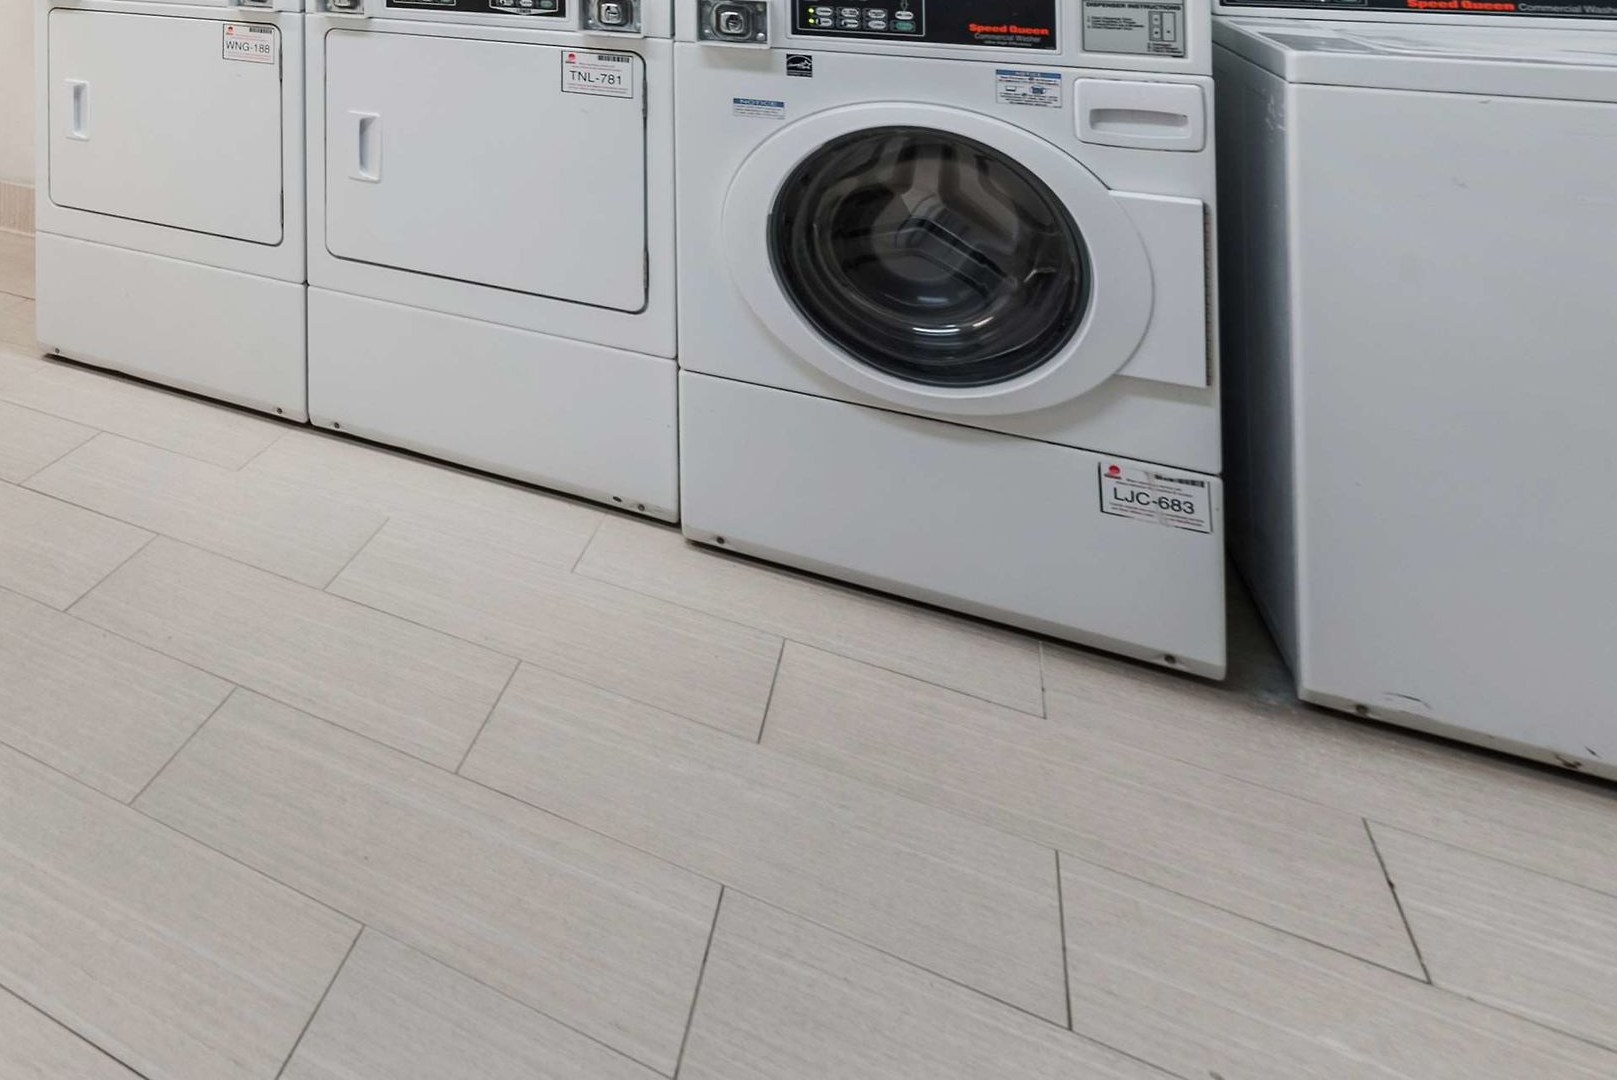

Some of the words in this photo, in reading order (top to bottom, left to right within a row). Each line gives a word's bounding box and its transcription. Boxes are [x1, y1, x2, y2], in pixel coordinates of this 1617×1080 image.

[1461, 0, 1515, 11] Queen
[1518, 3, 1582, 13] Commercial
[969, 23, 1007, 34] Speed
[1008, 25, 1050, 36] Queen
[226, 40, 271, 54] WNG-188
[569, 70, 622, 85] TNL-781
[1113, 486, 1196, 515] LJC-683
